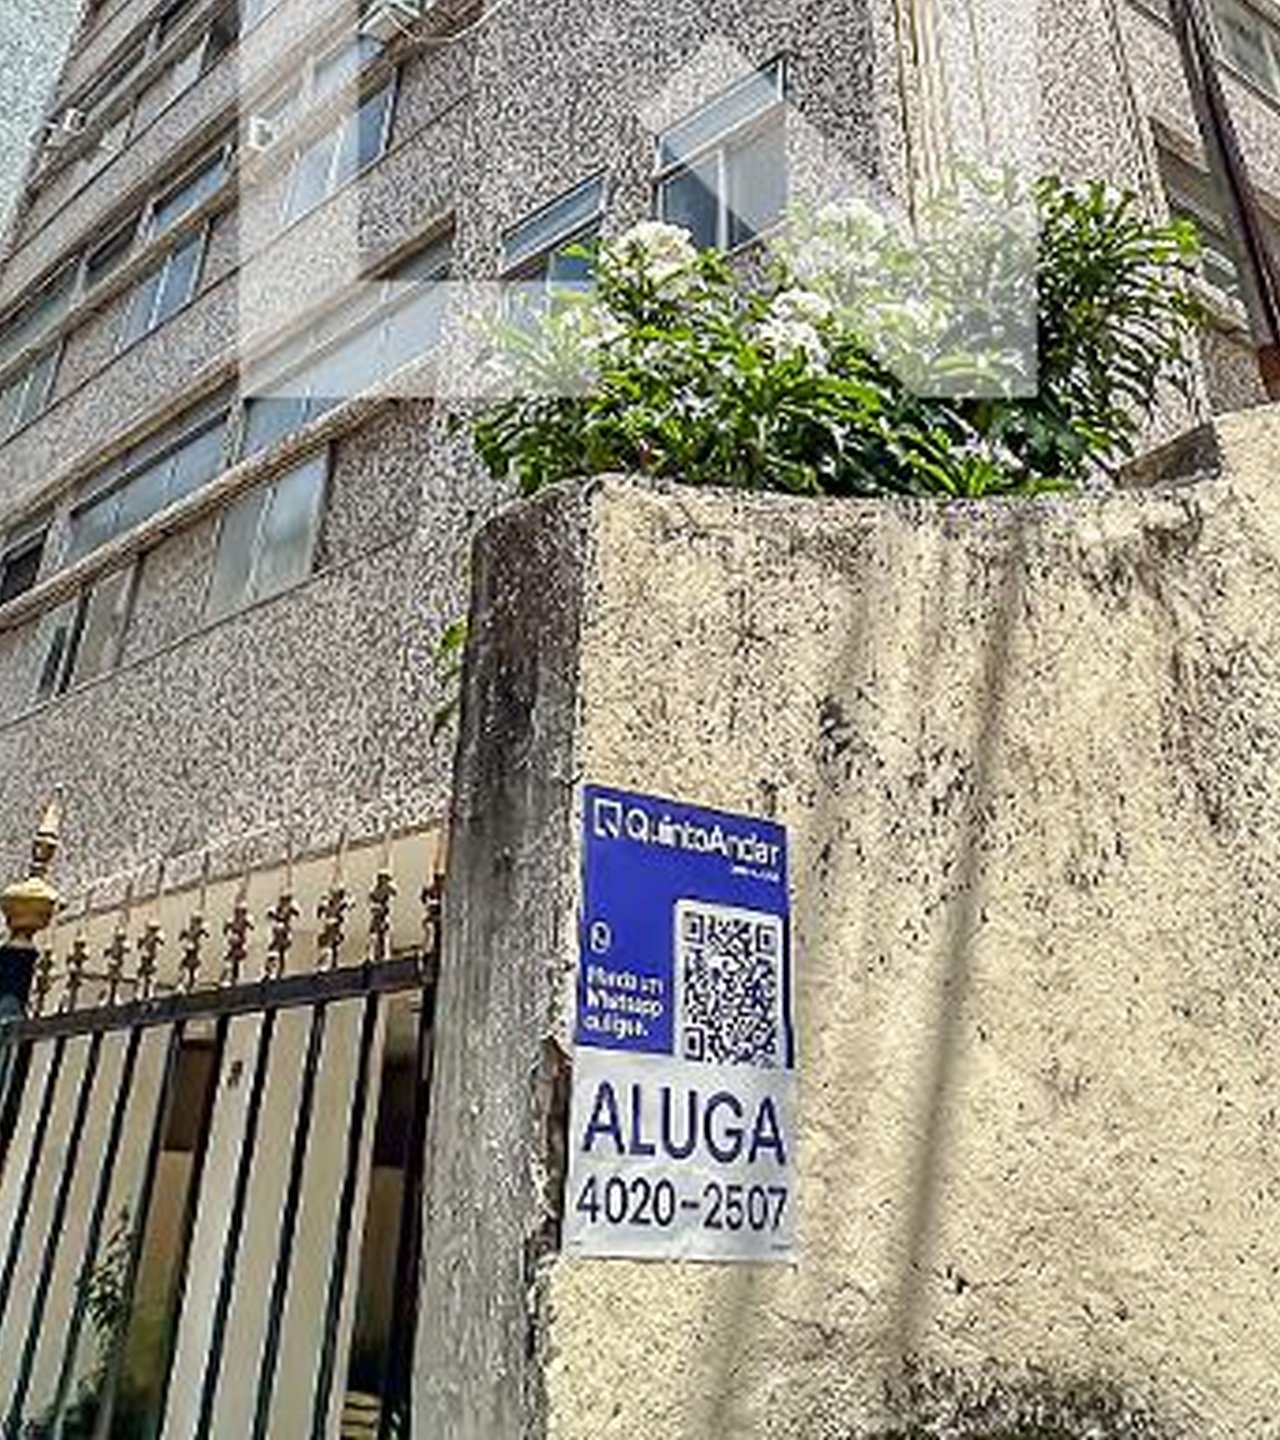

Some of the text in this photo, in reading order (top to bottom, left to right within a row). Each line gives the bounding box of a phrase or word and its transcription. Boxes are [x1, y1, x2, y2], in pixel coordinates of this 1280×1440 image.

[625, 808, 780, 866] QuintoAndar
[582, 1080, 786, 1165] ALUGA
[576, 1176, 788, 1231] 4020-2507
